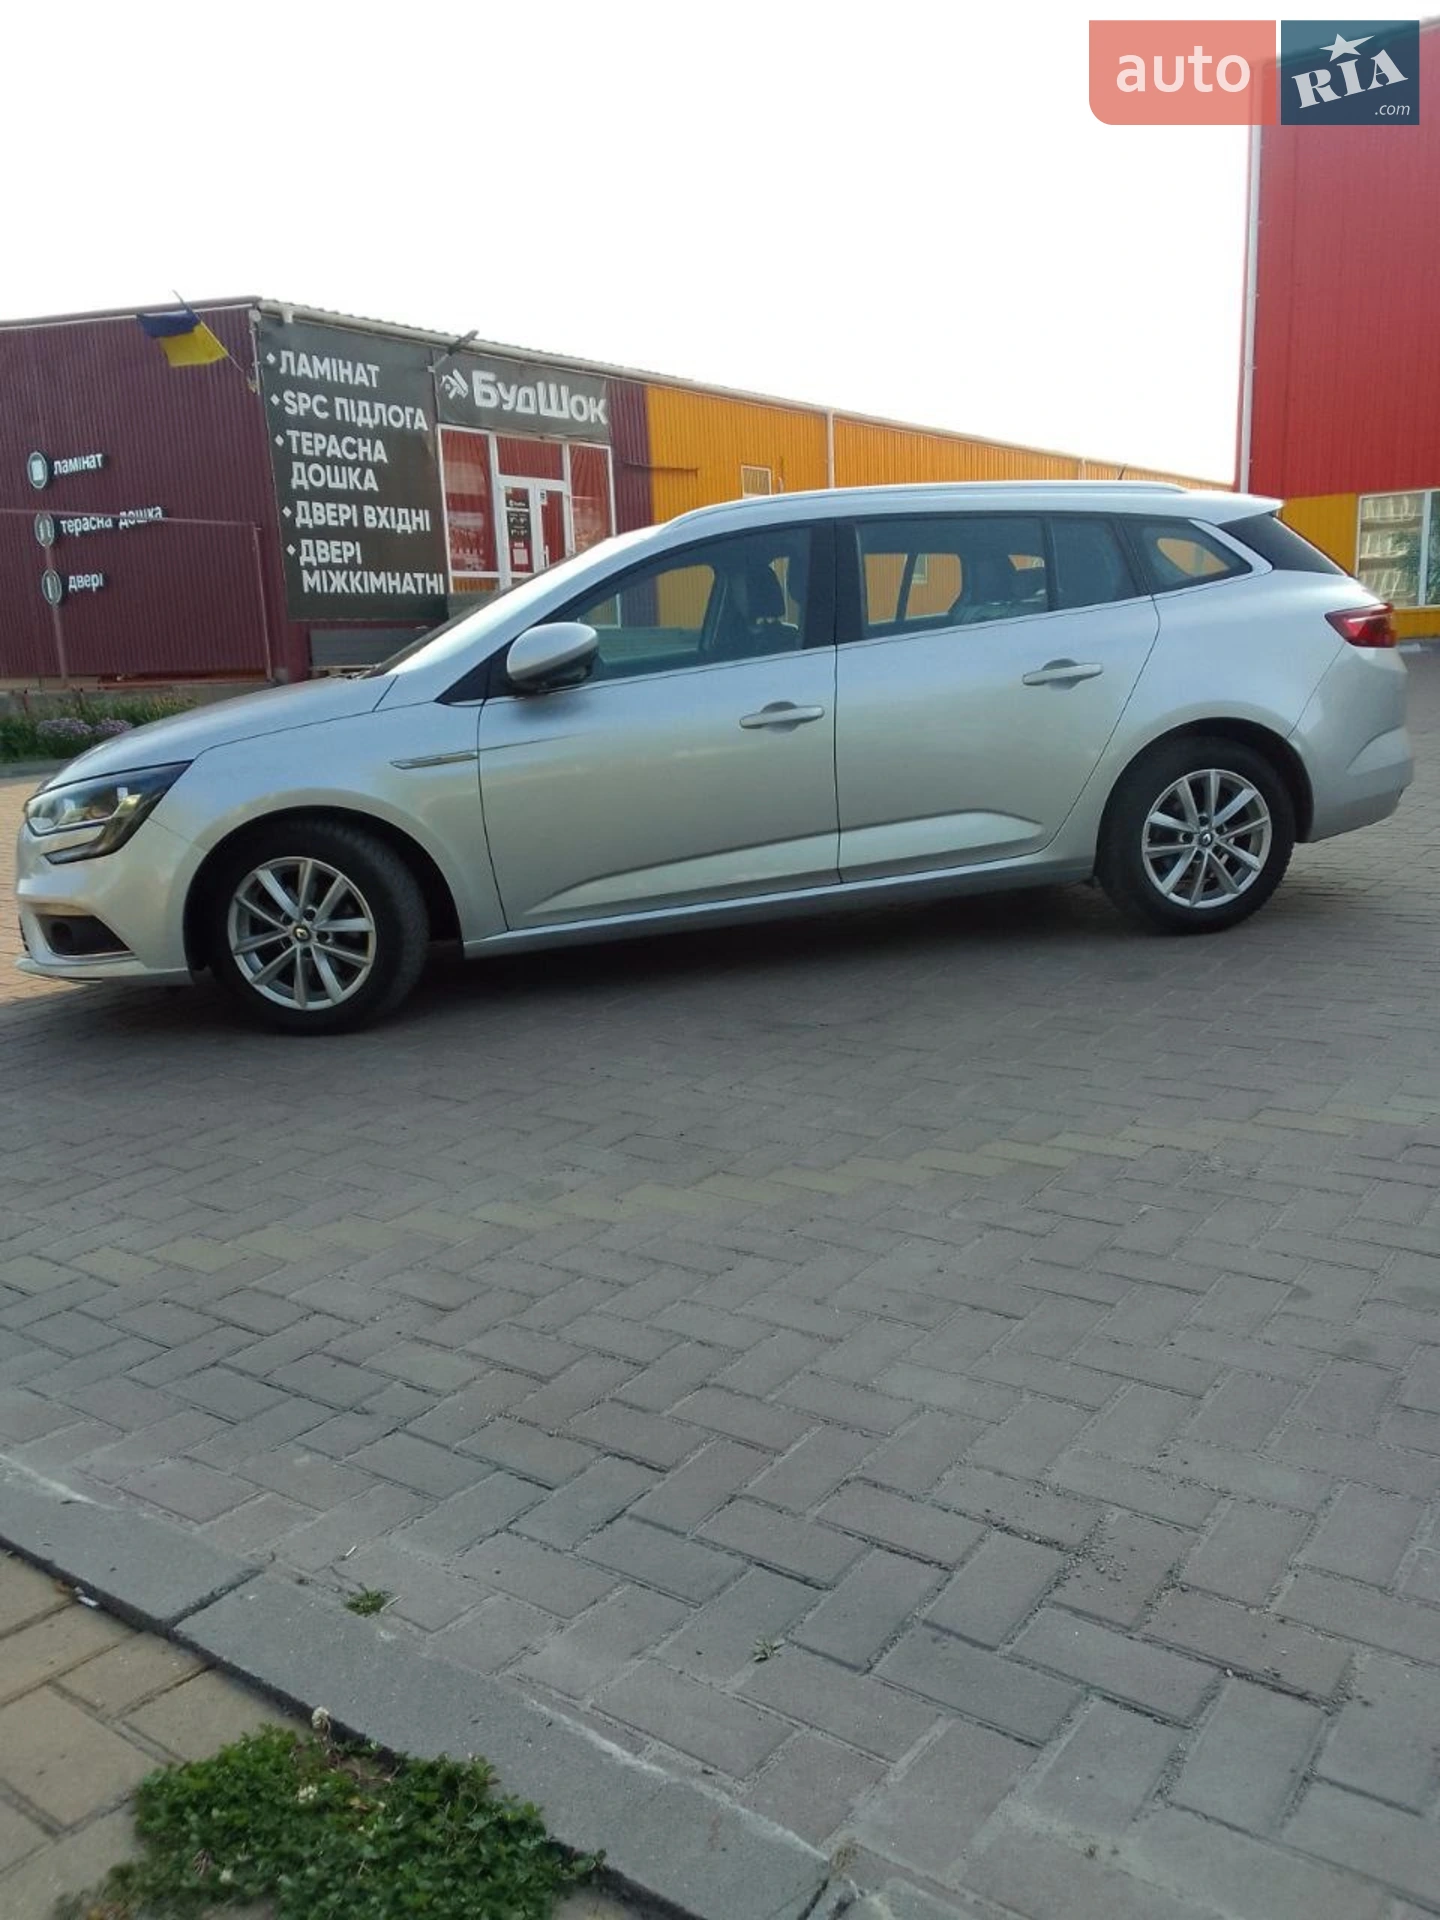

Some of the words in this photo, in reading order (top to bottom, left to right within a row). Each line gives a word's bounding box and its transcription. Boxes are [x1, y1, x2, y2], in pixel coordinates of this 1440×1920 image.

[279, 350, 380, 389] ЛАМІНАТ
[283, 390, 329, 418] SPC
[334, 397, 429, 432] ПІДЛОГА
[286, 429, 388, 464] ТЕРАСНА
[54, 453, 103, 475] ламінат
[290, 462, 379, 492] ДОШКА
[60, 516, 113, 536] терасна
[295, 500, 358, 530] ДВЕРІ
[364, 504, 431, 535] ВХІДНІ
[299, 539, 362, 568] ДВЕРІ
[68, 572, 104, 592] двері
[302, 568, 446, 596] МІЖКІМНАТНІ
